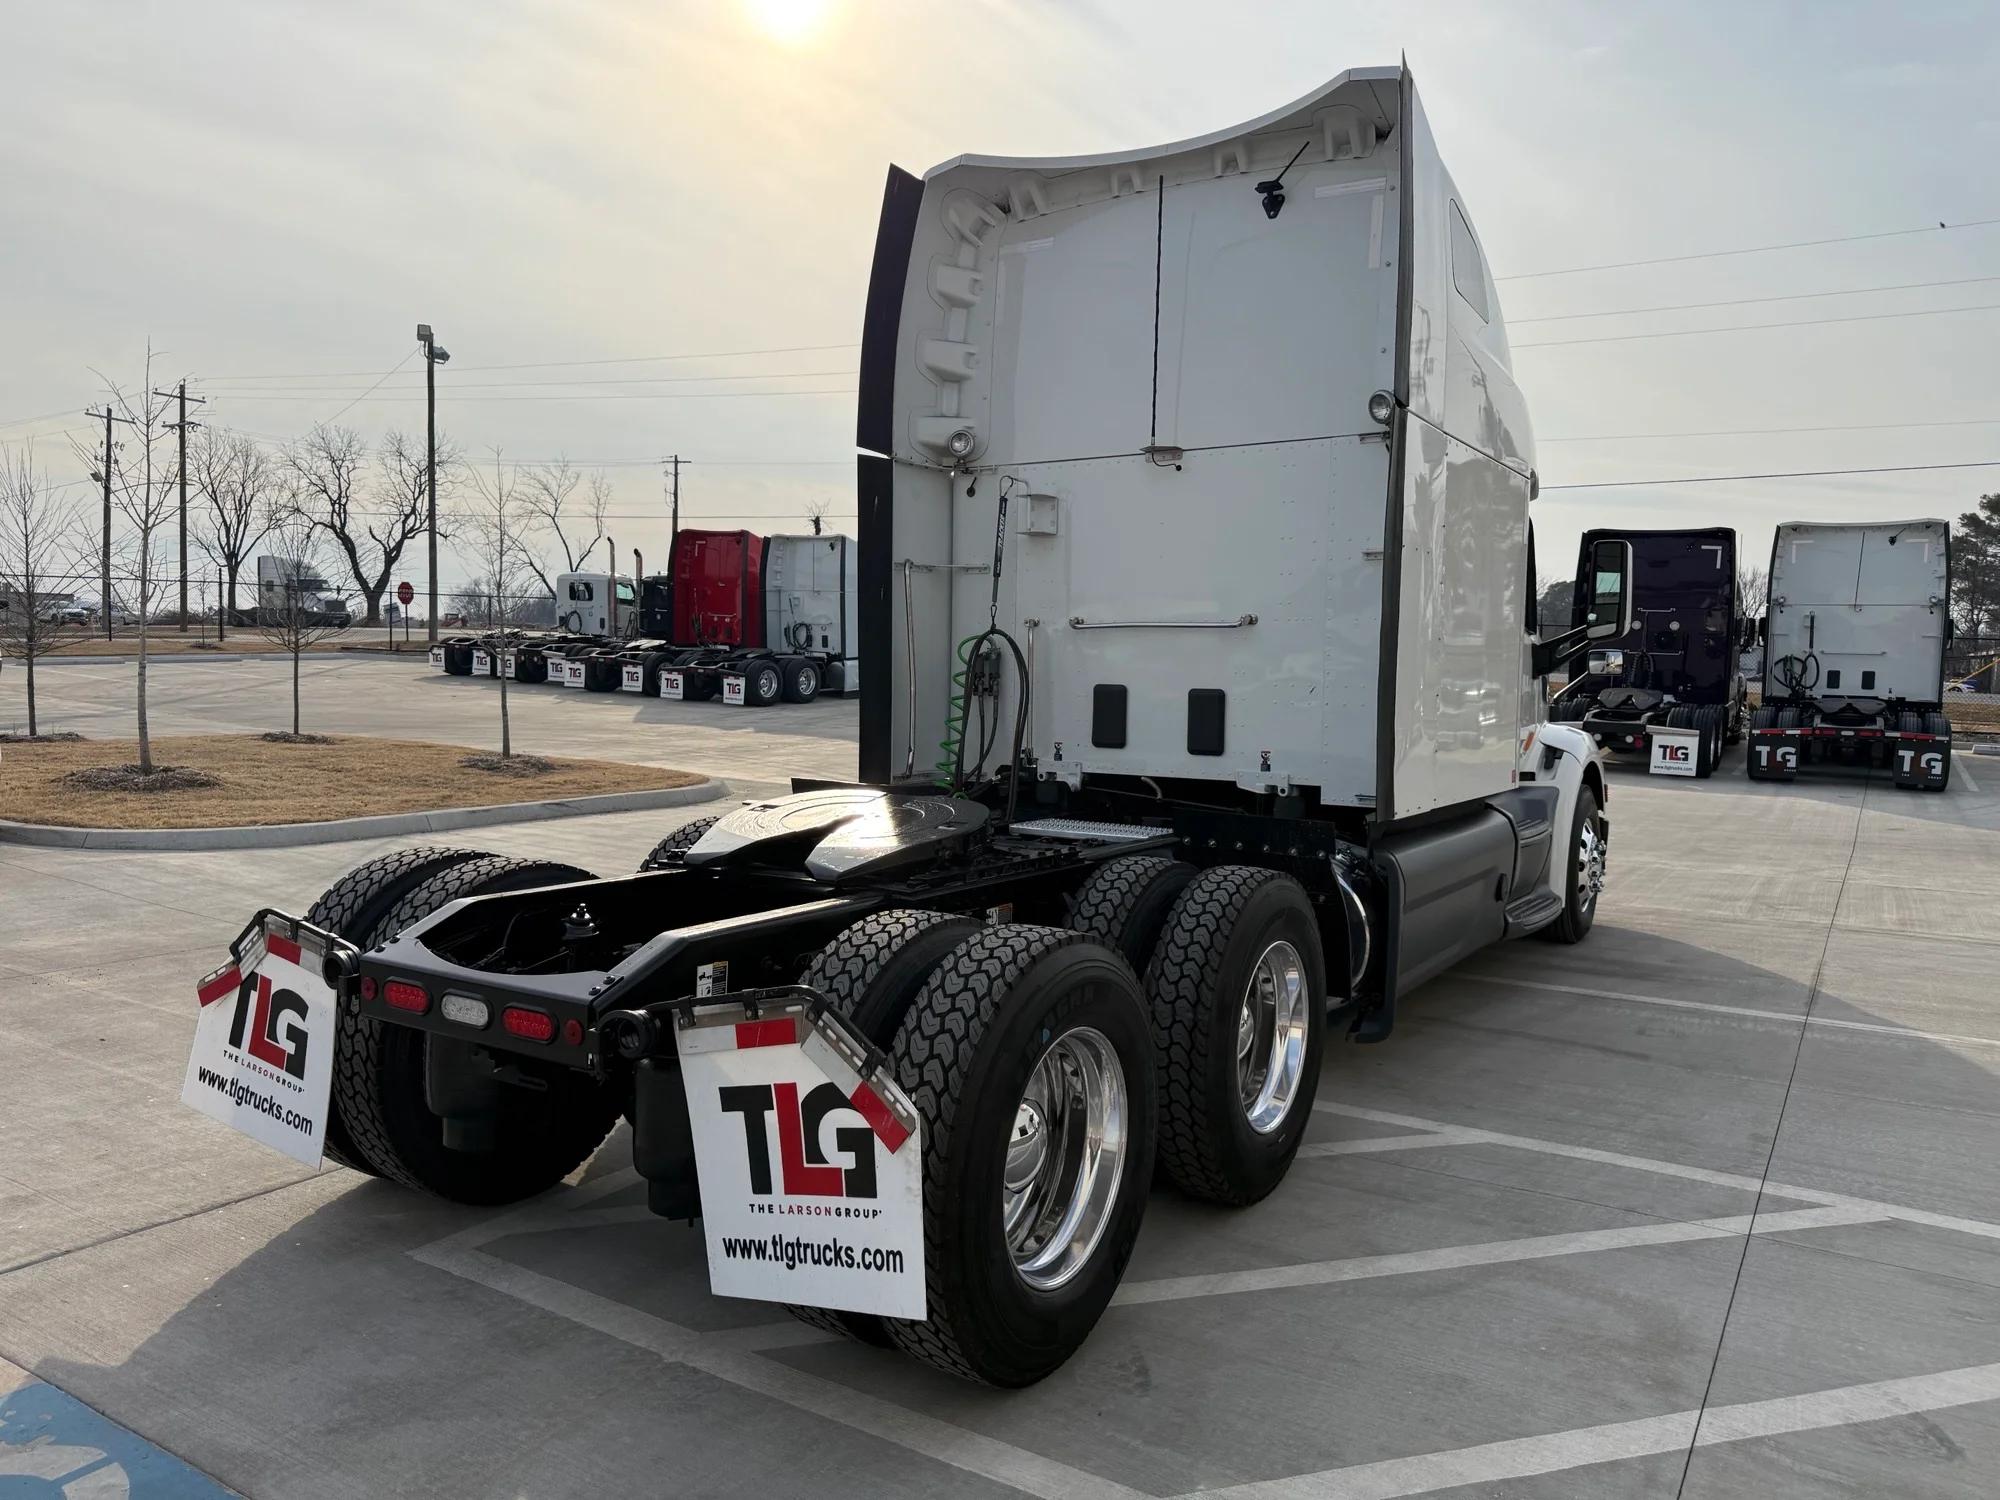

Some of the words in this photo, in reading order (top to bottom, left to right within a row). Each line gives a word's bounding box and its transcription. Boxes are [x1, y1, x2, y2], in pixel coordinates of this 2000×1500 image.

[665, 678, 679, 689] TLG
[726, 683, 741, 694] TLG
[1658, 744, 1689, 761] TLG
[1755, 745, 1797, 768] TG
[1898, 750, 1943, 775] TG
[228, 970, 309, 1081] TLG
[223, 1050, 239, 1063] THE
[198, 1066, 313, 1136] www.tlgtrucks.com
[718, 1082, 878, 1199] TLG
[749, 1203, 774, 1214] THE
[722, 1233, 904, 1274] www.tlgtrucks.com
